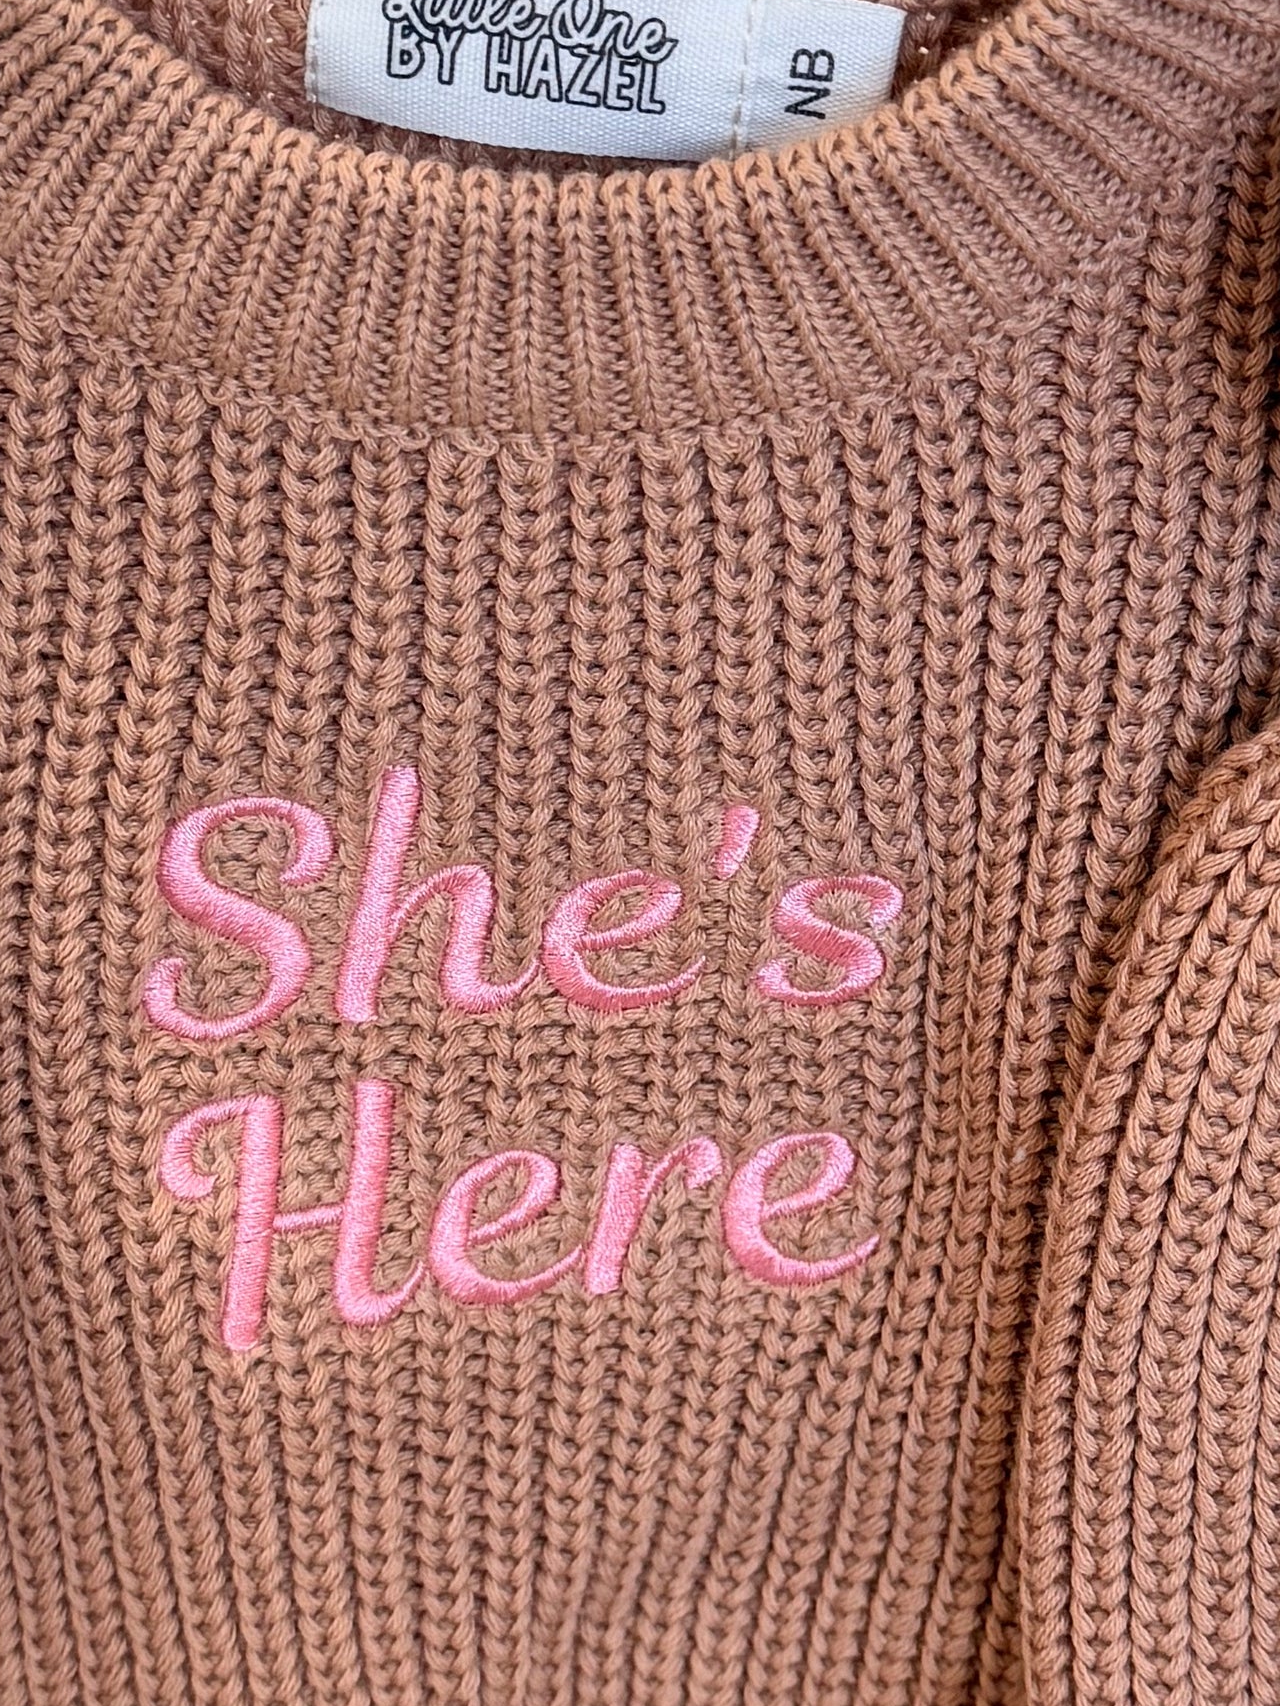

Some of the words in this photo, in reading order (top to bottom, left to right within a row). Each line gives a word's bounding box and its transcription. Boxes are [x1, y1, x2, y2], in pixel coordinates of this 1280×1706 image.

[387, 21, 466, 85] BY
[484, 33, 666, 115] HAZEL
[784, 48, 835, 120] NB
[142, 764, 906, 1041] She's
[158, 1079, 881, 1353] Here
